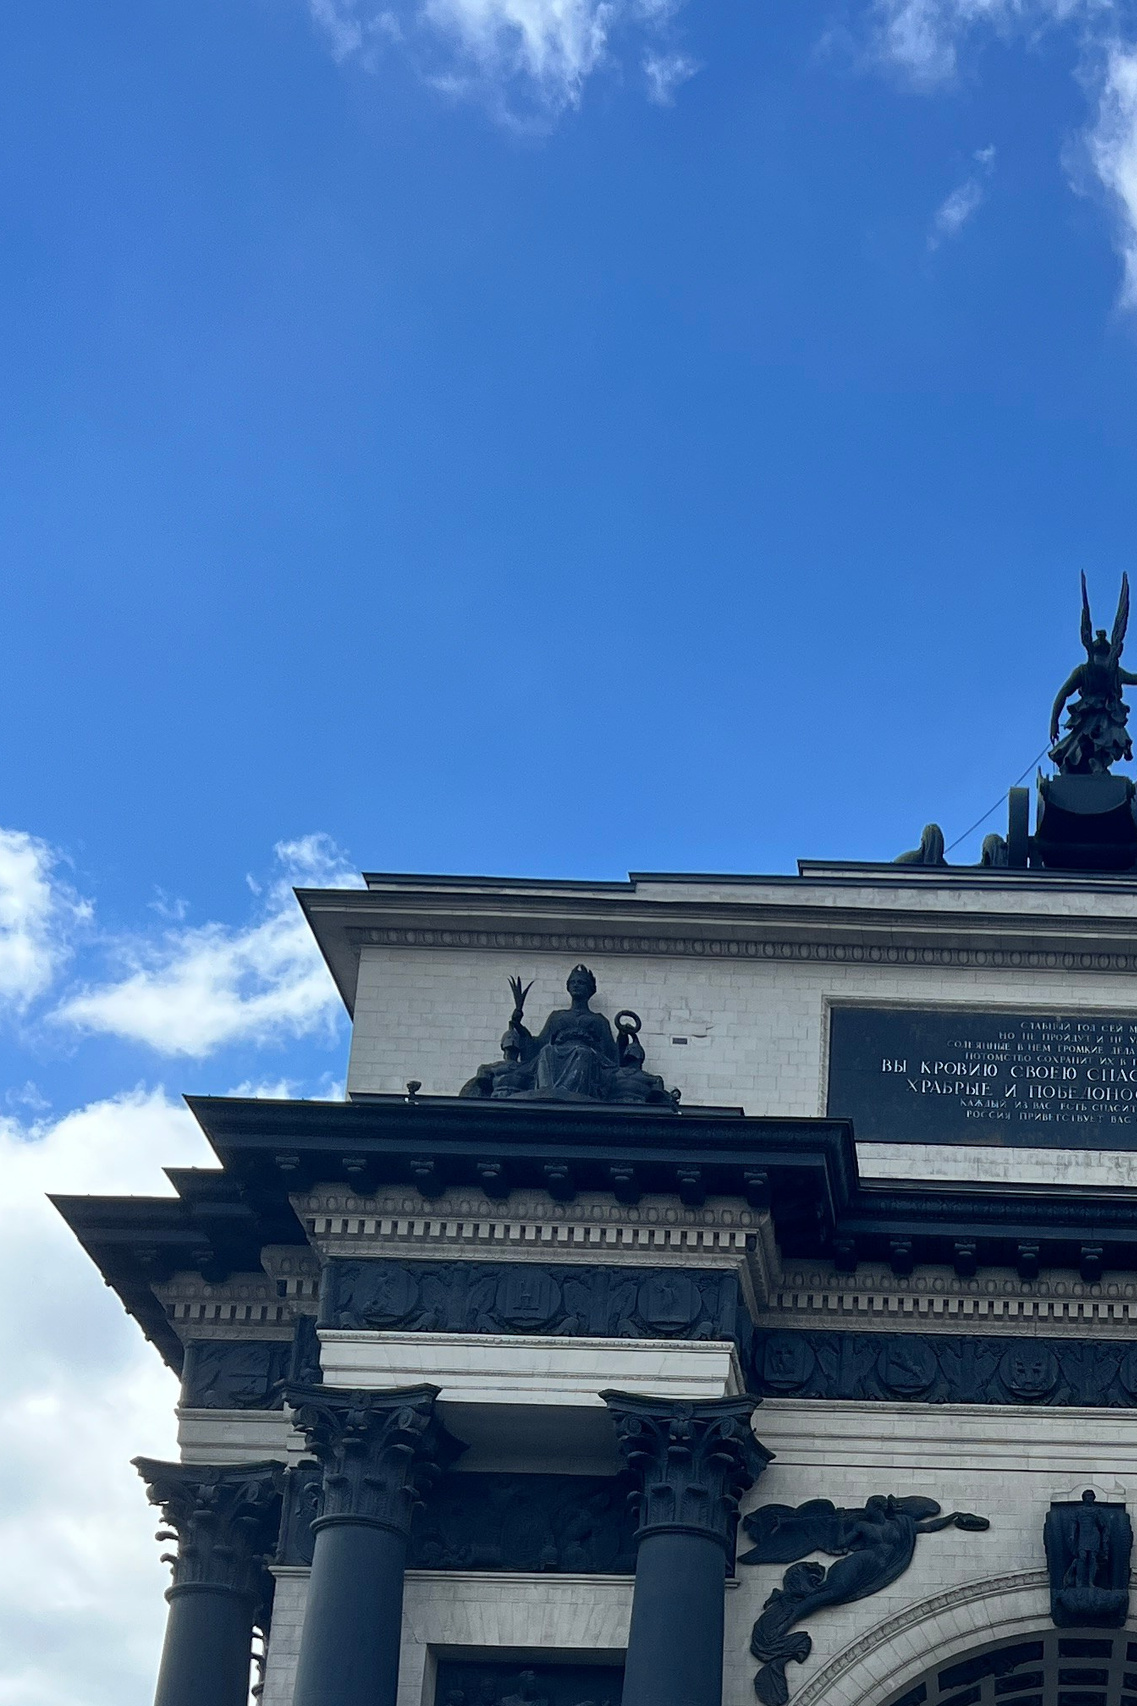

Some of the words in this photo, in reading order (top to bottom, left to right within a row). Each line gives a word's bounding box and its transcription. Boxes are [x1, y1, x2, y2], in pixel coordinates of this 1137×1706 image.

[1077, 1023, 1096, 1032] ГОД
[999, 1032, 1015, 1040] НО
[1096, 1035, 1103, 1043] И
[1058, 1045, 1103, 1054] ГРОМКИЕ
[965, 1052, 1031, 1062] ПОТОМСТВО
[1100, 1057, 1115, 1065] ИХ
[1120, 1058, 1127, 1066] В
[881, 1058, 907, 1073] ВЫ
[920, 1060, 998, 1077] КРОВИЮ
[1010, 1065, 1077, 1080] СВОЕЮ
[906, 1078, 993, 1096] ХРАБРЫЕ
[1004, 1084, 1017, 1098] И
[1014, 1100, 1028, 1109] ИЗ
[1032, 1101, 1051, 1110] ВАС
[966, 1110, 1011, 1120] РОССИЯ
[1110, 1115, 1131, 1124] ВАС
